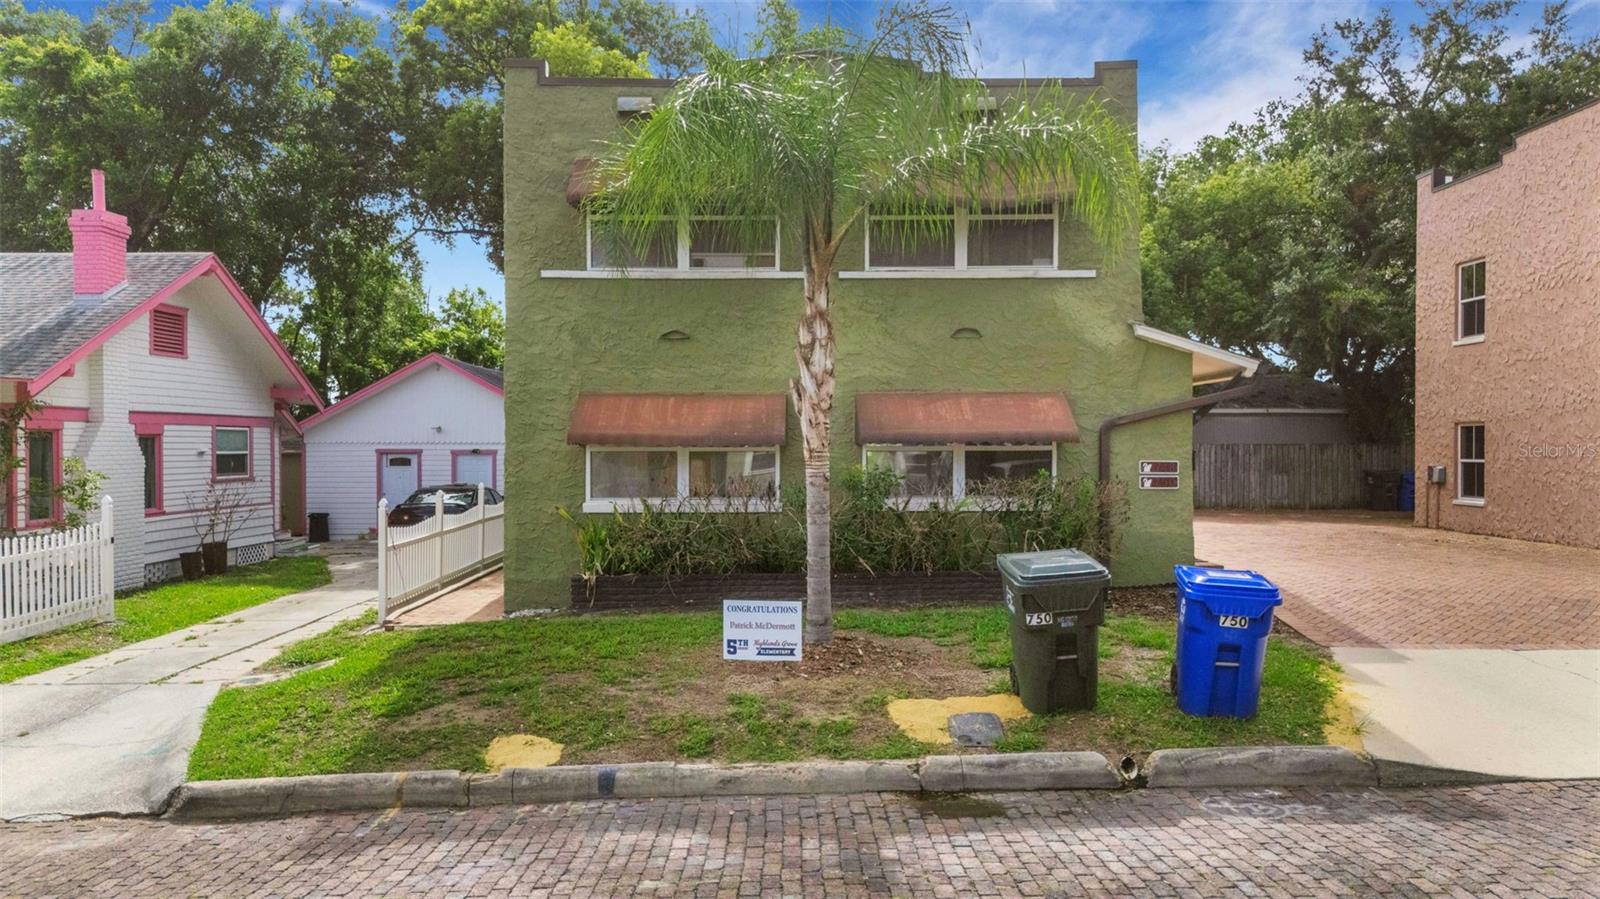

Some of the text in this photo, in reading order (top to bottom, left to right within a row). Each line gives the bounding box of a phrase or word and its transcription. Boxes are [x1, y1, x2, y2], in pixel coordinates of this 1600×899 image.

[727, 604, 798, 614] CONGRATULATIONS
[1027, 613, 1052, 624] 750
[1222, 616, 1247, 627] 750
[730, 620, 796, 630] Patrick McDermott
